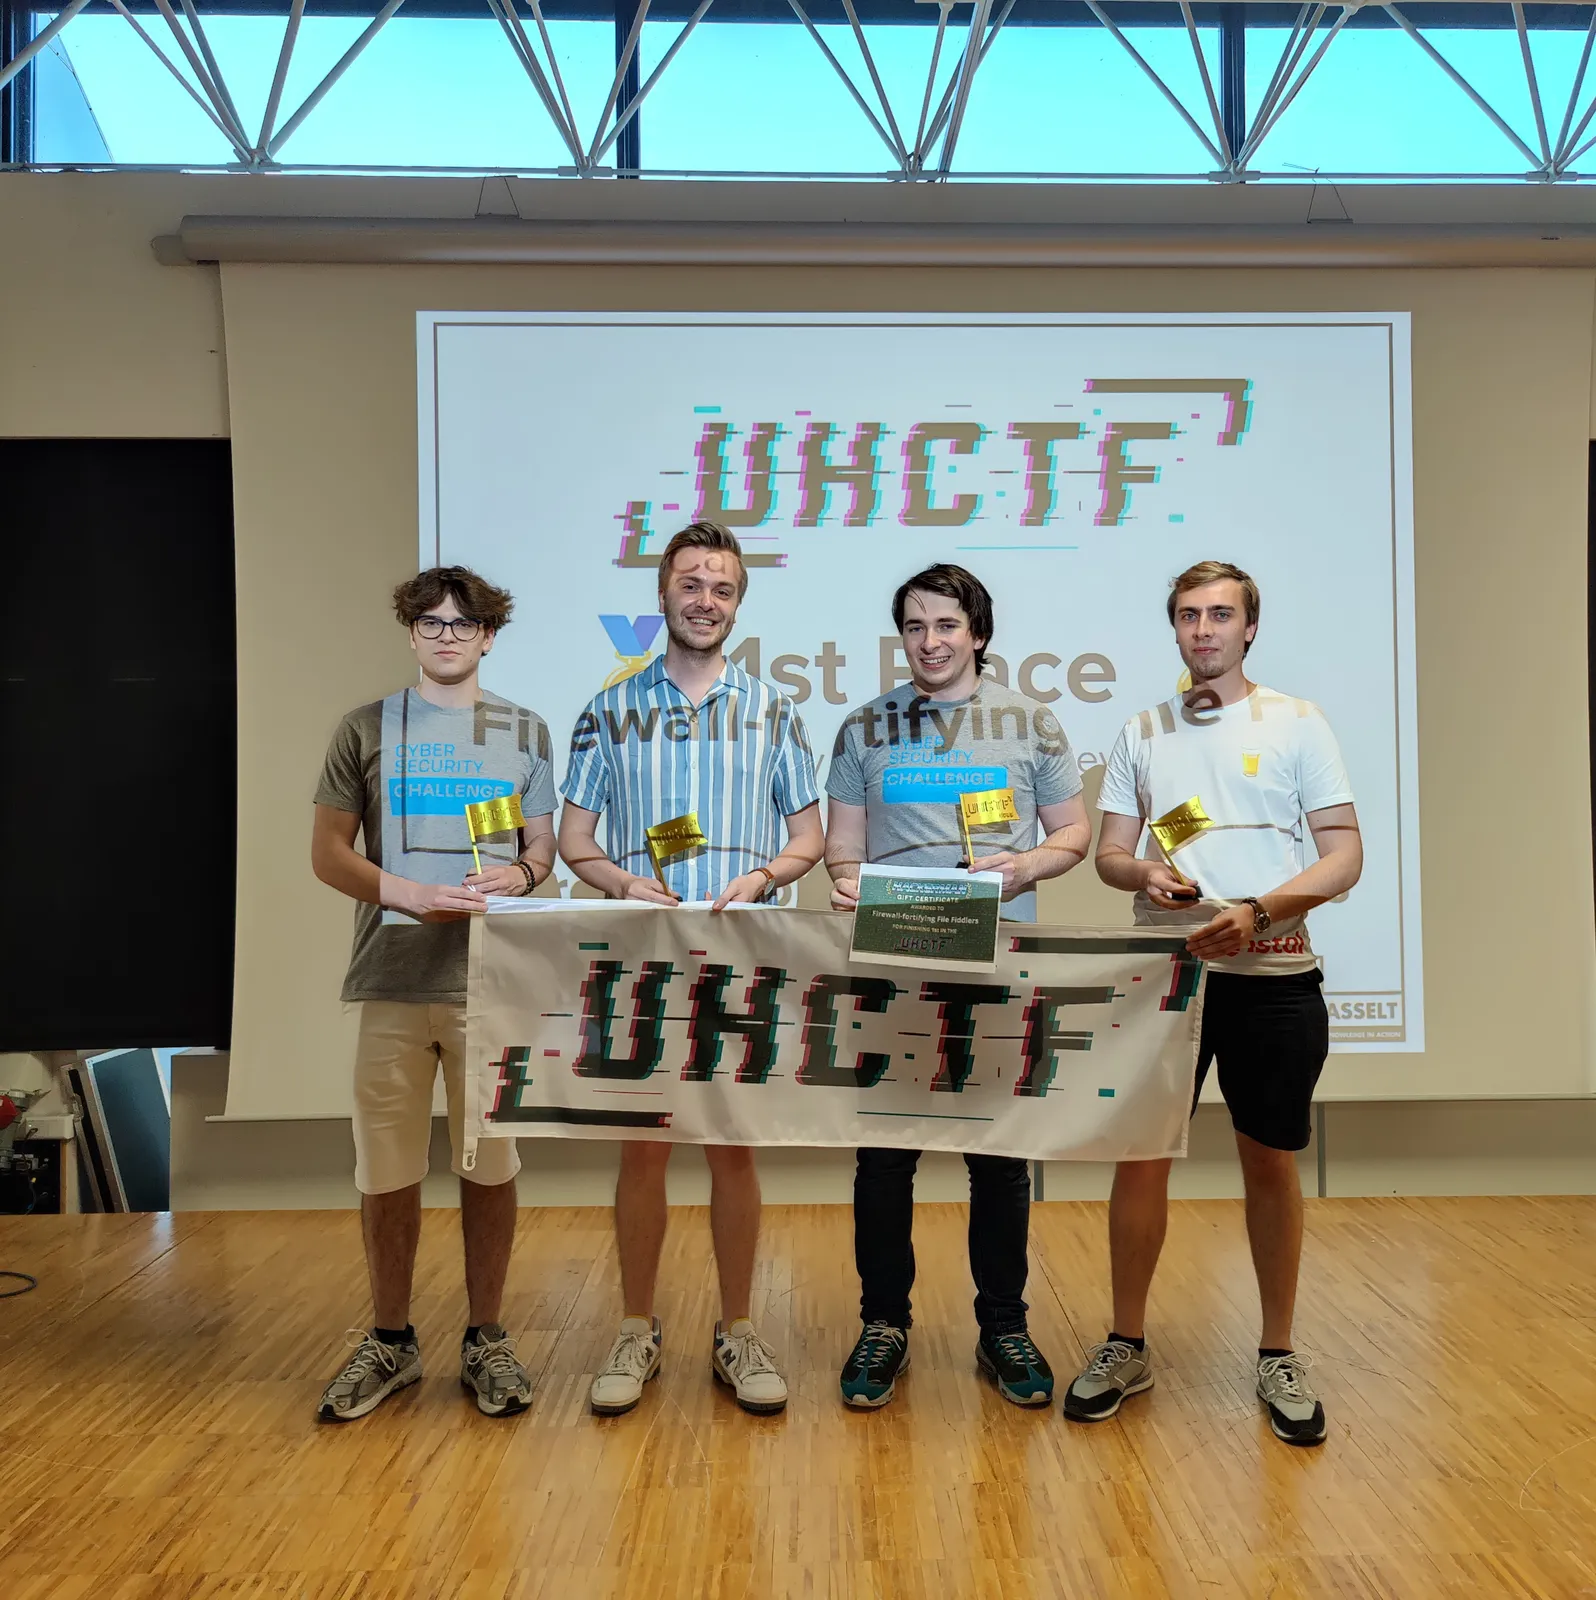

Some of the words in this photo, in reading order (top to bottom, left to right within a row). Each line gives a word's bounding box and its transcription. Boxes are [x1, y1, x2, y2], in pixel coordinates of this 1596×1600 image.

[692, 421, 1180, 527] UHCTF
[729, 637, 848, 705] 1st
[880, 636, 1116, 704] Pce
[395, 743, 456, 757] CYBER
[889, 749, 974, 765] SECURITY
[395, 759, 484, 773] SECURITY
[887, 772, 995, 786] CHALLENGE
[393, 783, 505, 798] CHALLENGE
[915, 895, 960, 903] CERTIFICATE
[872, 910, 936, 925] Firewall-fortifying
[937, 915, 950, 923] File
[951, 916, 979, 925] Fiddlers
[1328, 1002, 1398, 1020] ASSELT
[573, 960, 1117, 1098] UHCTF
[1329, 1031, 1365, 1039] NOWLEDGE
